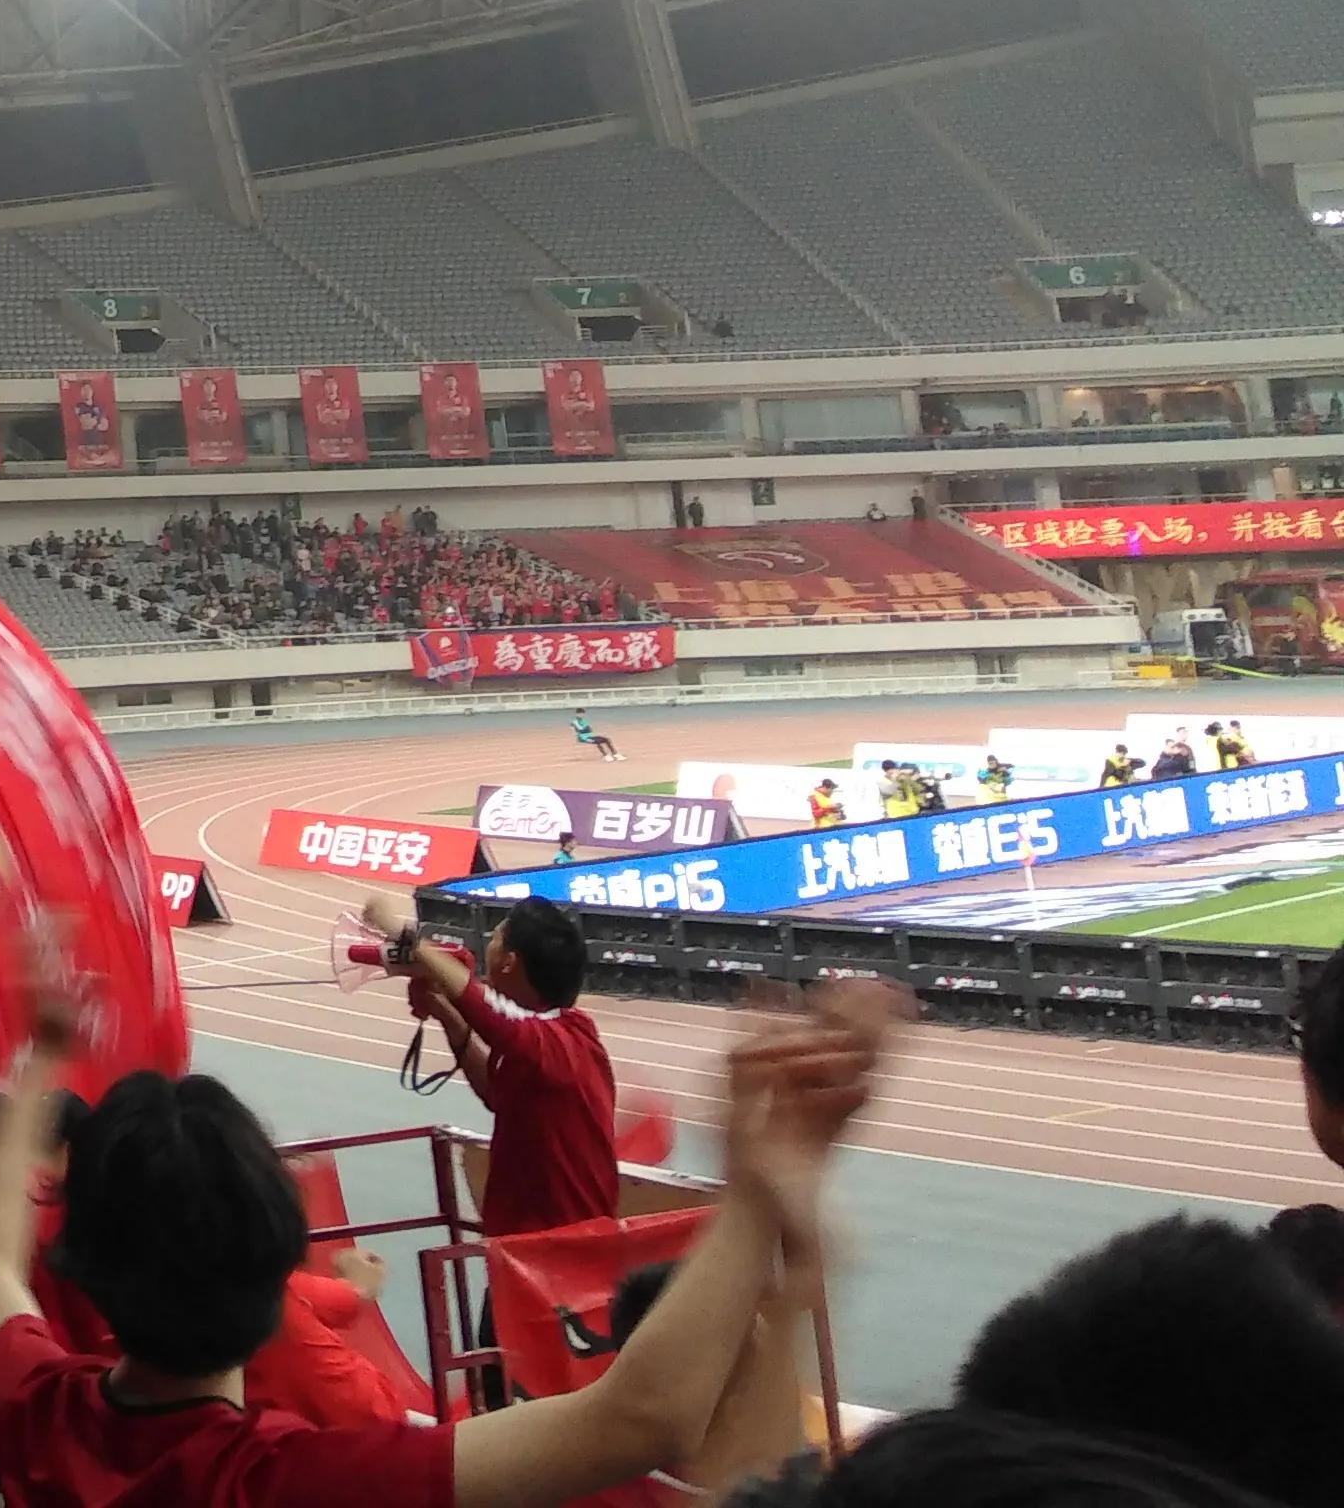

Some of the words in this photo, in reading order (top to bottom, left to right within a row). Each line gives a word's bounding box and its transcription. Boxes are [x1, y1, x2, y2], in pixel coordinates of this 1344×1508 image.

[1069, 265, 1086, 285] 6
[576, 287, 592, 305] 7
[103, 298, 118, 318] 8
[591, 799, 717, 846] 百岁山
[298, 823, 432, 875] 中国平安
